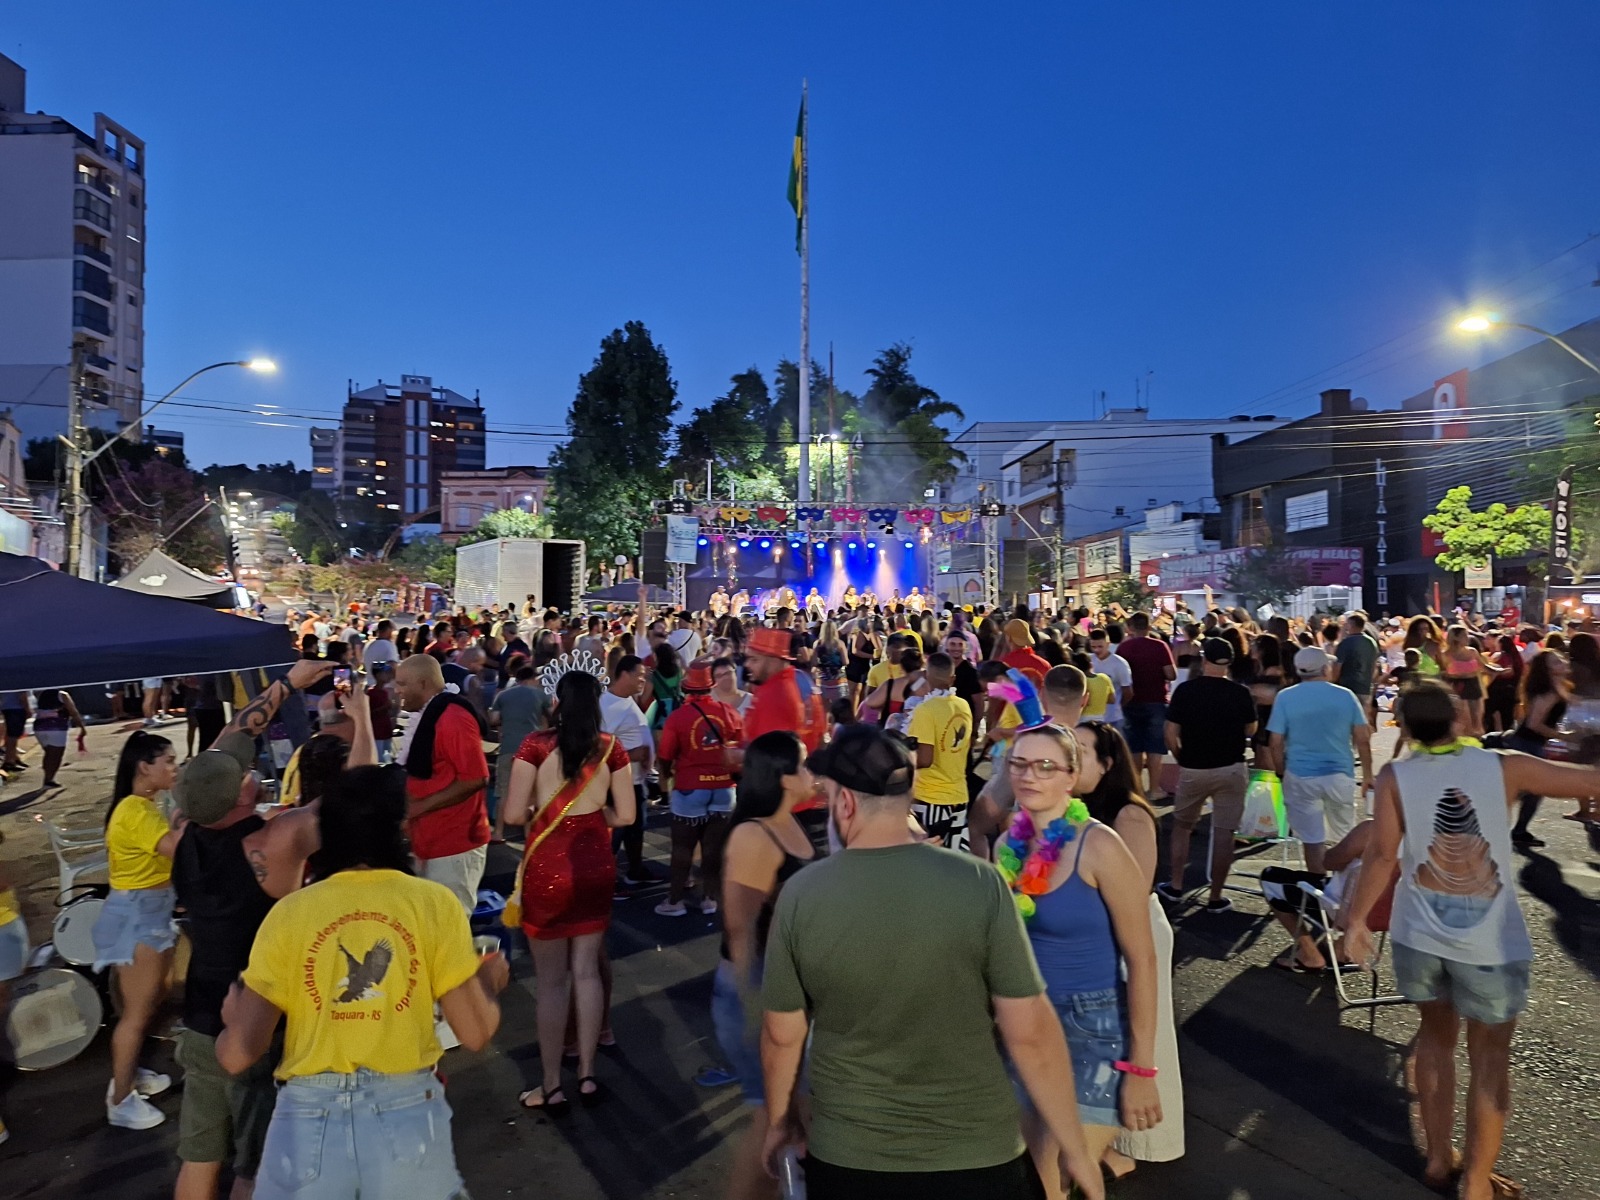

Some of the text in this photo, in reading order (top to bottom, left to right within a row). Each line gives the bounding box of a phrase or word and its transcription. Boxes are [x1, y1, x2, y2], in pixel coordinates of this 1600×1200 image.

[309, 911, 388, 954] Independente
[389, 917, 417, 955] Jardim
[409, 958, 421, 975] do
[330, 1010, 365, 1021] Taquara
[371, 1009, 382, 1021] RS
